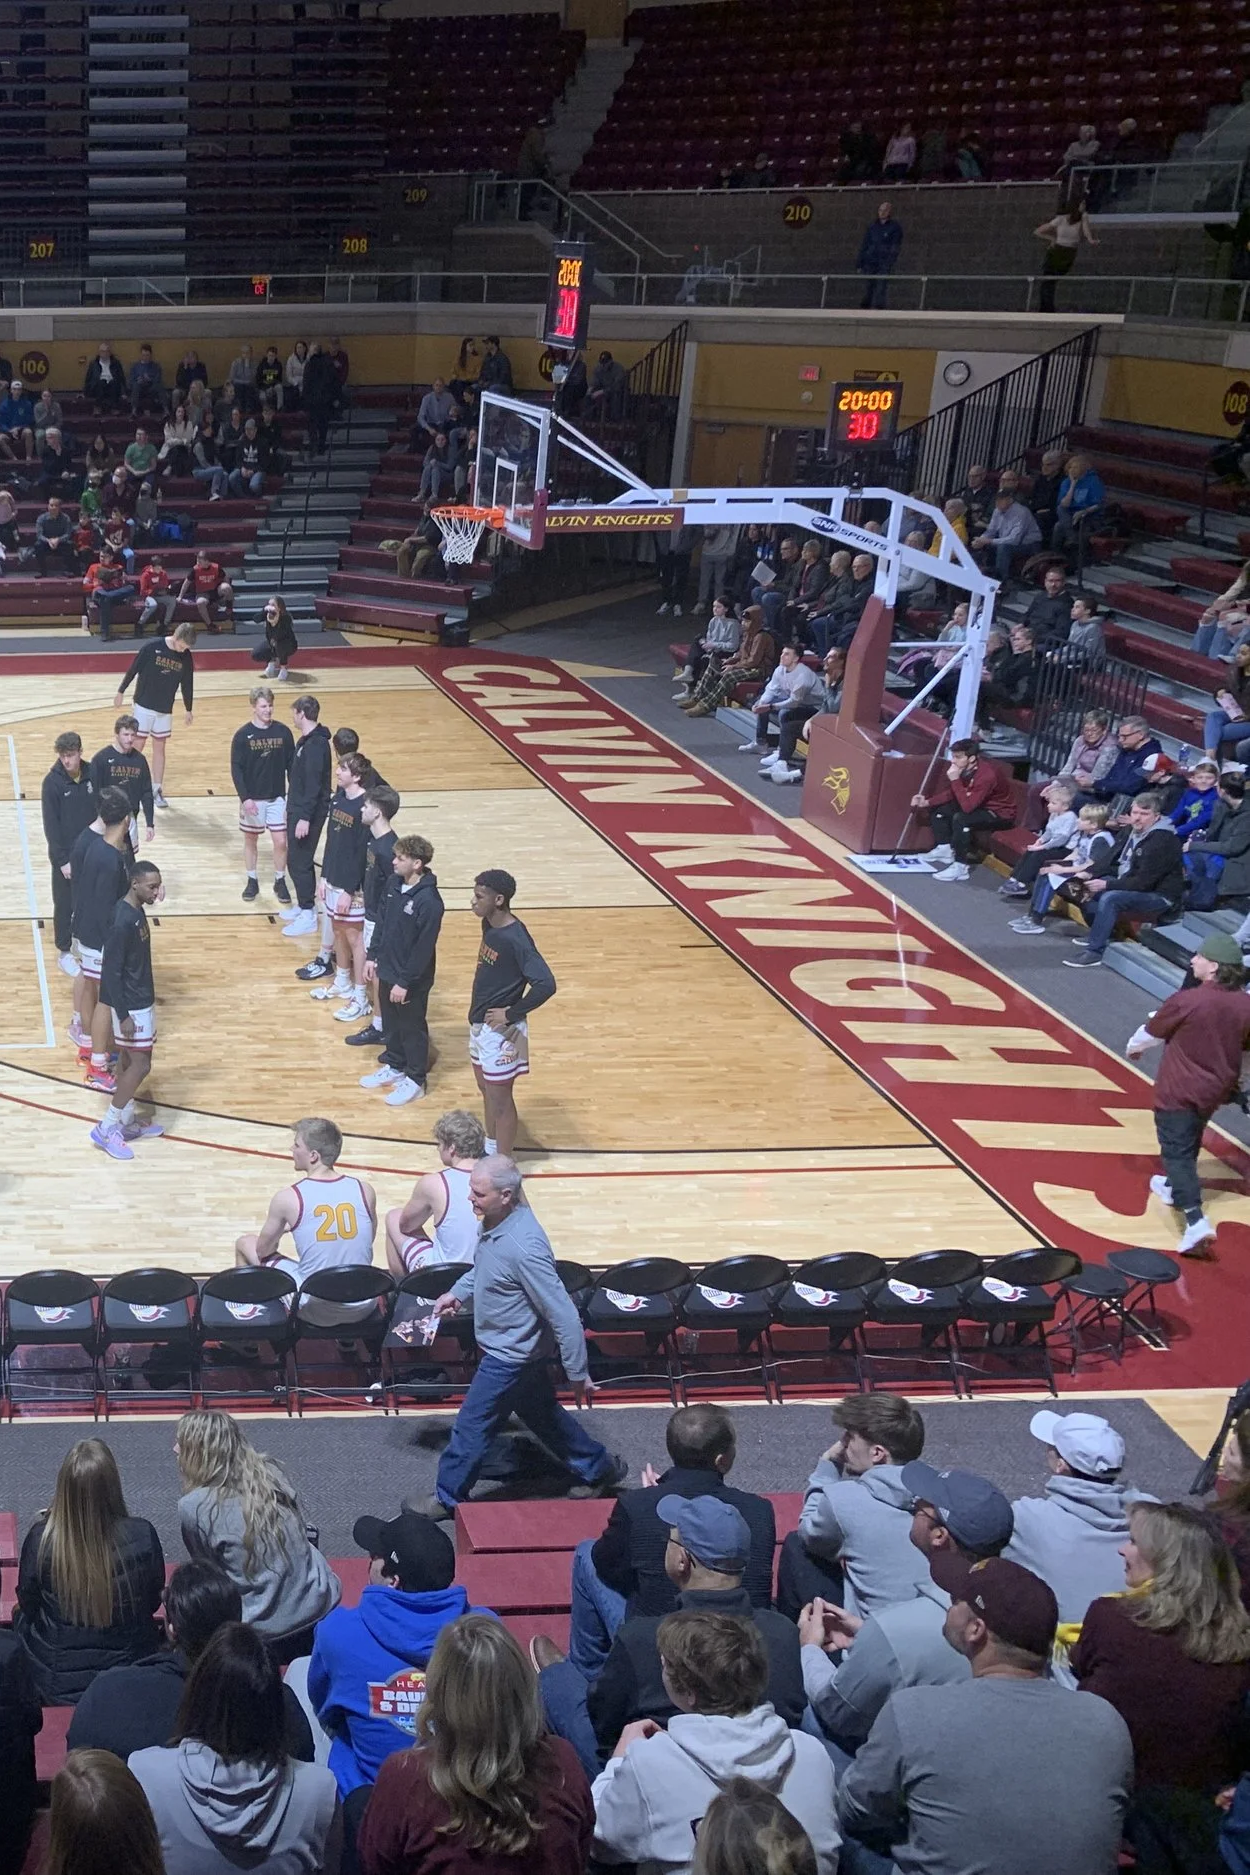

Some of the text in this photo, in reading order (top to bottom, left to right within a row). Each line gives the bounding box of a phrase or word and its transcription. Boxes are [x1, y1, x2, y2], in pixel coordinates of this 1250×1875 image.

[405, 189, 427, 202] 209
[785, 205, 810, 220] 210
[30, 243, 54, 258] 207
[342, 238, 367, 253] 208
[22, 360, 46, 374] 106
[838, 391, 893, 411] 20:00
[1225, 392, 1248, 414] 108
[847, 413, 879, 440] 30
[592, 513, 675, 526] KNIGHTS
[840, 527, 889, 552] SPORTS
[442, 664, 735, 807] CALVIN
[313, 1203, 358, 1242] 20
[396, 1680, 426, 1688] HEA
[379, 1700, 393, 1712] &
